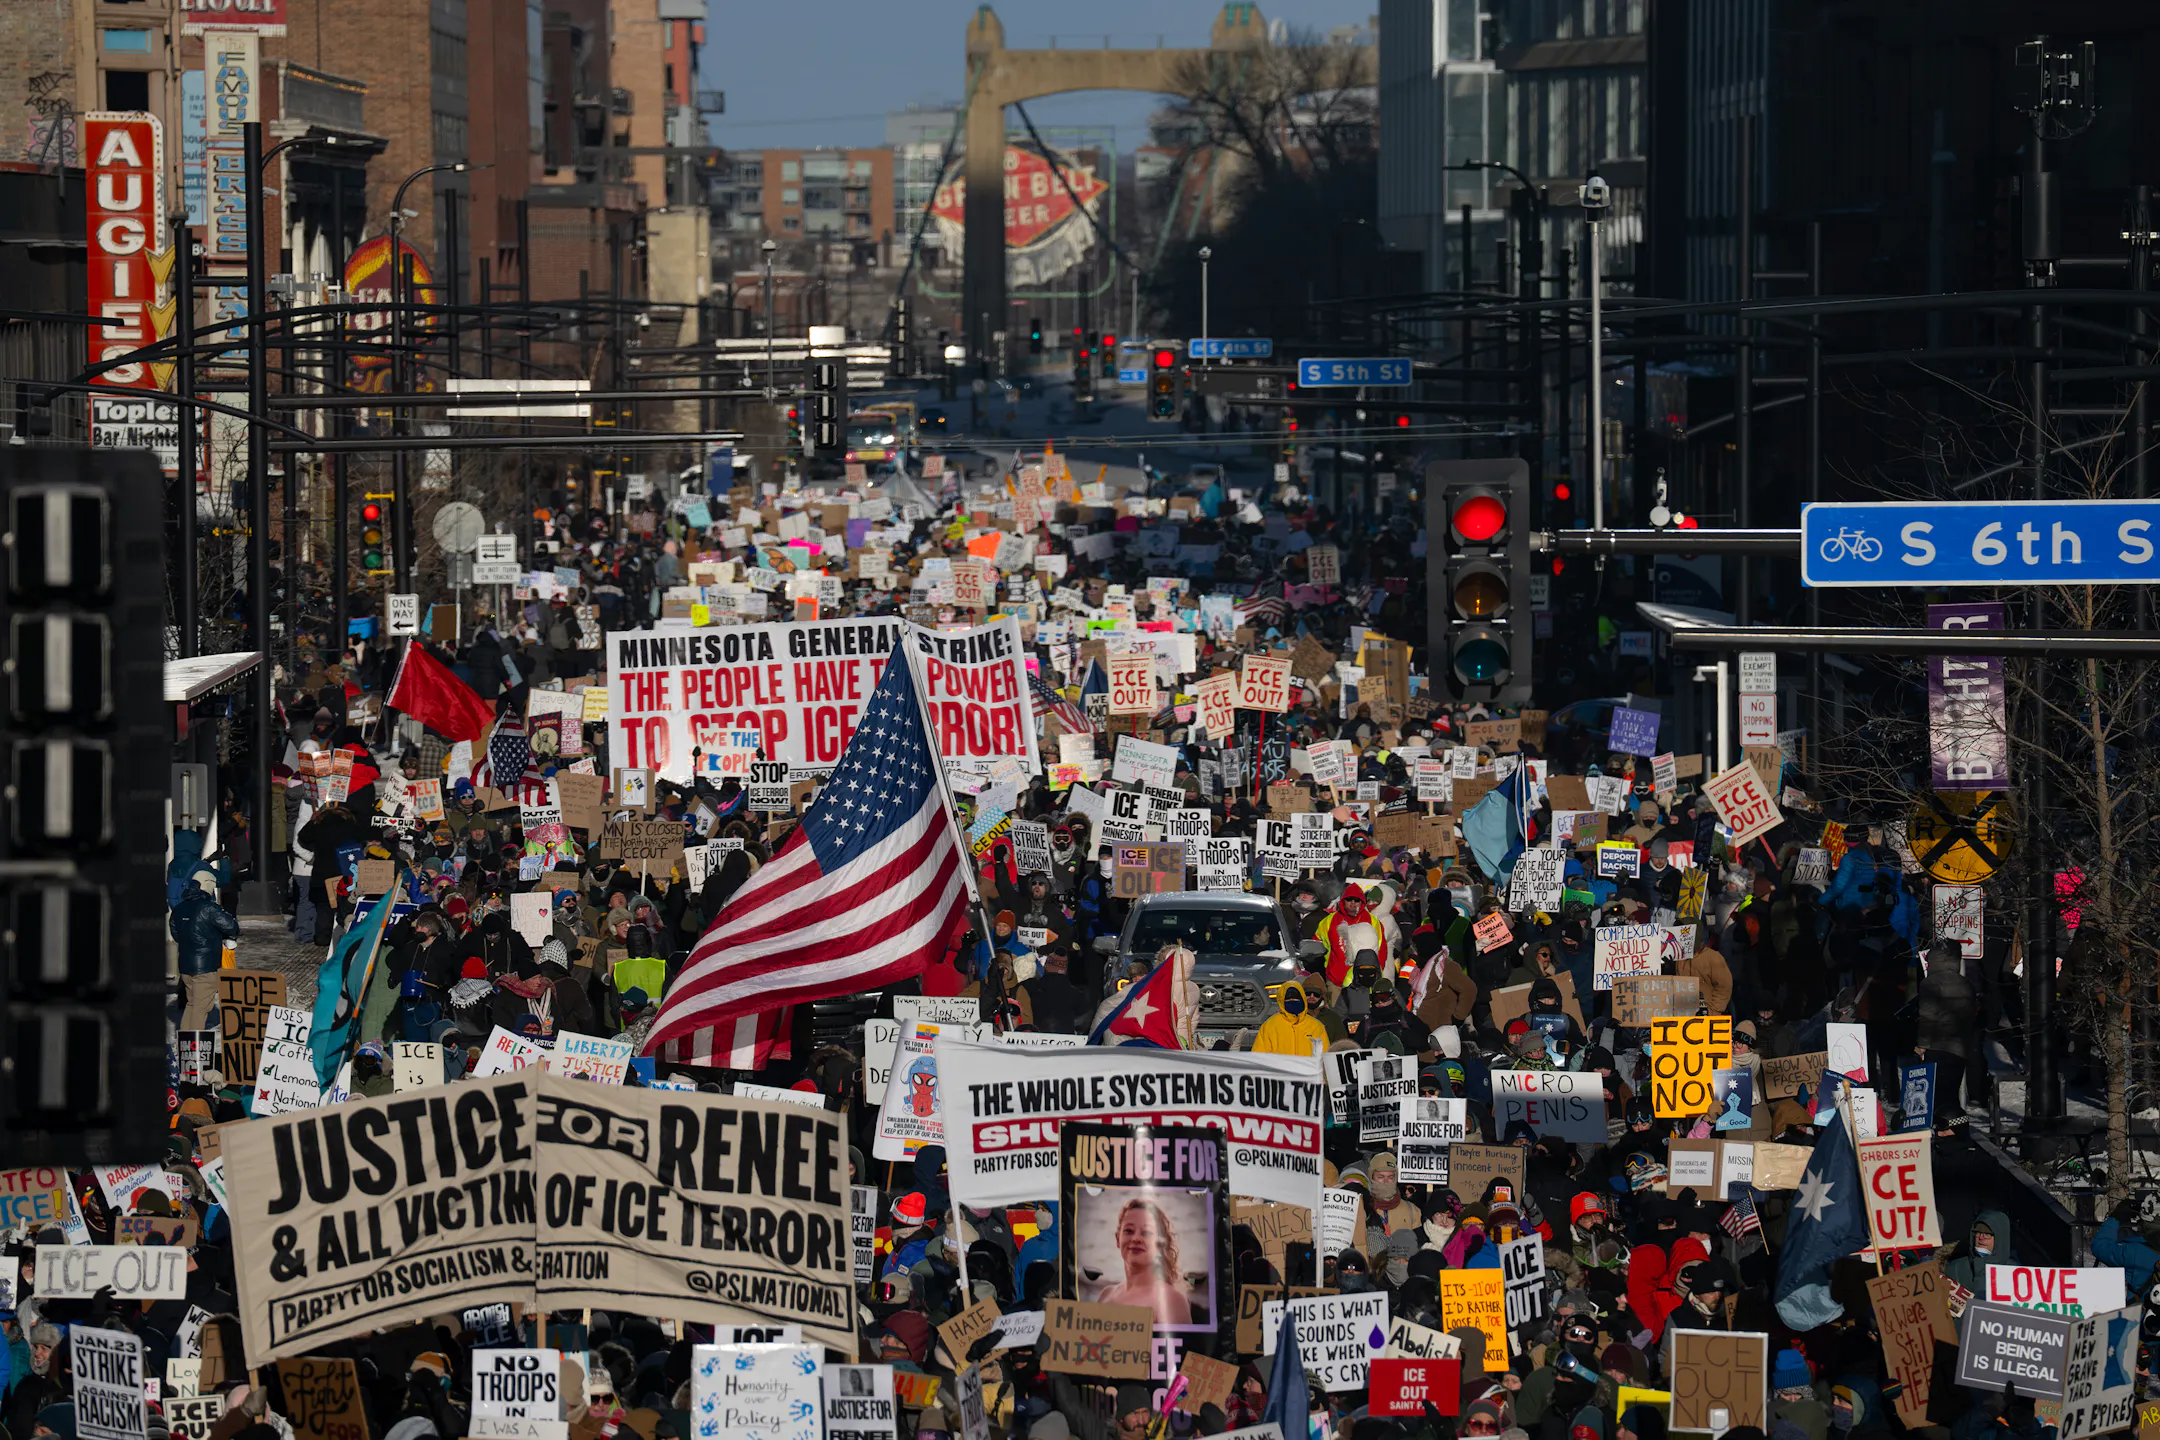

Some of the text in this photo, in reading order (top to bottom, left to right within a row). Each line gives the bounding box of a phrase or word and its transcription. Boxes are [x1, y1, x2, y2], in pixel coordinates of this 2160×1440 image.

[214, 51, 250, 136] FAMOUS
[1308, 364, 1403, 381] S 5th St
[1900, 521, 1936, 566] S
[1971, 520, 2082, 567] 6th
[392, 598, 414, 609] ONE
[393, 609, 415, 619] WAY
[1743, 662, 1772, 671] EXEMPT
[619, 670, 672, 713] THE
[681, 663, 785, 710] PEOPLE
[793, 659, 862, 703] HAVE
[926, 657, 1019, 704] POWER
[1112, 669, 1148, 687] ICE
[1246, 667, 1283, 689] ICE
[1112, 688, 1152, 707] OUT!
[1201, 689, 1232, 712] ICE
[1243, 688, 1284, 708] OUT!
[1751, 701, 1765, 712] NO
[1205, 708, 1233, 730] OUT
[1743, 716, 1773, 726] STOPPING
[1118, 748, 1168, 766] MINNESOTA
[750, 762, 788, 784] STOP
[750, 787, 788, 797] ICE TERROR
[1144, 786, 1182, 802] GENERAL
[1713, 772, 1752, 798] NEIGHBORS SAY
[1112, 791, 1141, 820] ICE
[1717, 780, 1762, 816] ICE
[521, 809, 560, 818] OUT OF
[1177, 811, 1200, 820] NO
[1729, 799, 1772, 834] OUT!
[603, 820, 684, 838] MN IS CLOSED
[1102, 826, 1143, 843] MINNESOTA
[1103, 818, 1145, 832] OUT OF
[1169, 819, 1210, 836] TROOPS
[1265, 821, 1293, 849] ICE
[1014, 832, 1047, 850] STRIKE
[1207, 840, 1231, 850] NO
[1121, 848, 1147, 859] ICE
[1198, 849, 1240, 865] TROOPS
[1540, 849, 1566, 862] YOUR
[1602, 852, 1636, 862] DEPORT
[1602, 862, 1636, 872] RACISTS
[1121, 870, 1167, 895] OUT
[1199, 874, 1241, 887] MINNESOTA
[1947, 894, 1967, 910] NO
[1596, 923, 1661, 943] COMPLEXION
[1608, 940, 1650, 956] SHOULD
[1603, 955, 1650, 973] NOT BE
[220, 975, 278, 1006] ICE
[274, 1007, 304, 1024] USES
[1652, 1018, 1731, 1046] ICE
[402, 1043, 436, 1060] ICE
[565, 1037, 633, 1061] LIBERTY
[563, 1056, 624, 1080] JUSTICE
[1654, 1052, 1729, 1079] OUT
[1908, 1066, 1927, 1078] CHINGA
[409, 1069, 425, 1085] is
[1499, 1072, 1574, 1094] MICRO
[968, 1073, 1322, 1118] THE WHOLE SYSTEM IS GUILTY!
[1360, 1079, 1417, 1101] JUSTICE FOR
[1505, 1096, 1589, 1125] PENIS
[1402, 1122, 1463, 1139] JUSTICE FOR
[267, 1082, 845, 1215] JUSTICE FOR RENEE
[1068, 1133, 1220, 1182] JUSTICE FOR
[973, 1145, 1321, 1184] PARTY FOR @PSLNATIONAL
[1737, 1172, 1749, 1181] DUE
[269, 1168, 847, 1283] & ALL VICTIM OF ICE TERROR!
[1505, 1241, 1540, 1281] ICE
[40, 1249, 184, 1295] ICE OUT
[1989, 1266, 2079, 1305] LOVE
[1445, 1300, 1503, 1314] I'D RATHER
[1506, 1282, 1544, 1329] OUT
[1055, 1305, 1145, 1342] Minnesota
[1979, 1319, 2065, 1349] NO HUMAN
[2077, 1320, 2096, 1339] THE
[74, 1333, 138, 1355] JAN.23
[1297, 1322, 1356, 1353] SOUNDS
[1676, 1336, 1761, 1368] ICE
[1995, 1340, 2044, 1363] BEING
[76, 1346, 141, 1390] STRIKE
[494, 1355, 541, 1372] NO
[1972, 1354, 2060, 1383] IS ILLEGAL
[2067, 1359, 2100, 1386] GRAVE
[1403, 1368, 1426, 1382] ICE
[1674, 1365, 1763, 1400] OUT
[81, 1384, 139, 1402] AGAINST
[477, 1371, 558, 1403] TROOPS
[725, 1374, 796, 1399] Humanity
[1399, 1384, 1429, 1401] OUT
[2068, 1382, 2093, 1403] YARD
[80, 1396, 143, 1434] RACISM
[170, 1402, 219, 1421] ICE
[505, 1406, 526, 1418] IN
[725, 1407, 783, 1433] Policy
[827, 1398, 894, 1421] JUSTICE FOR
